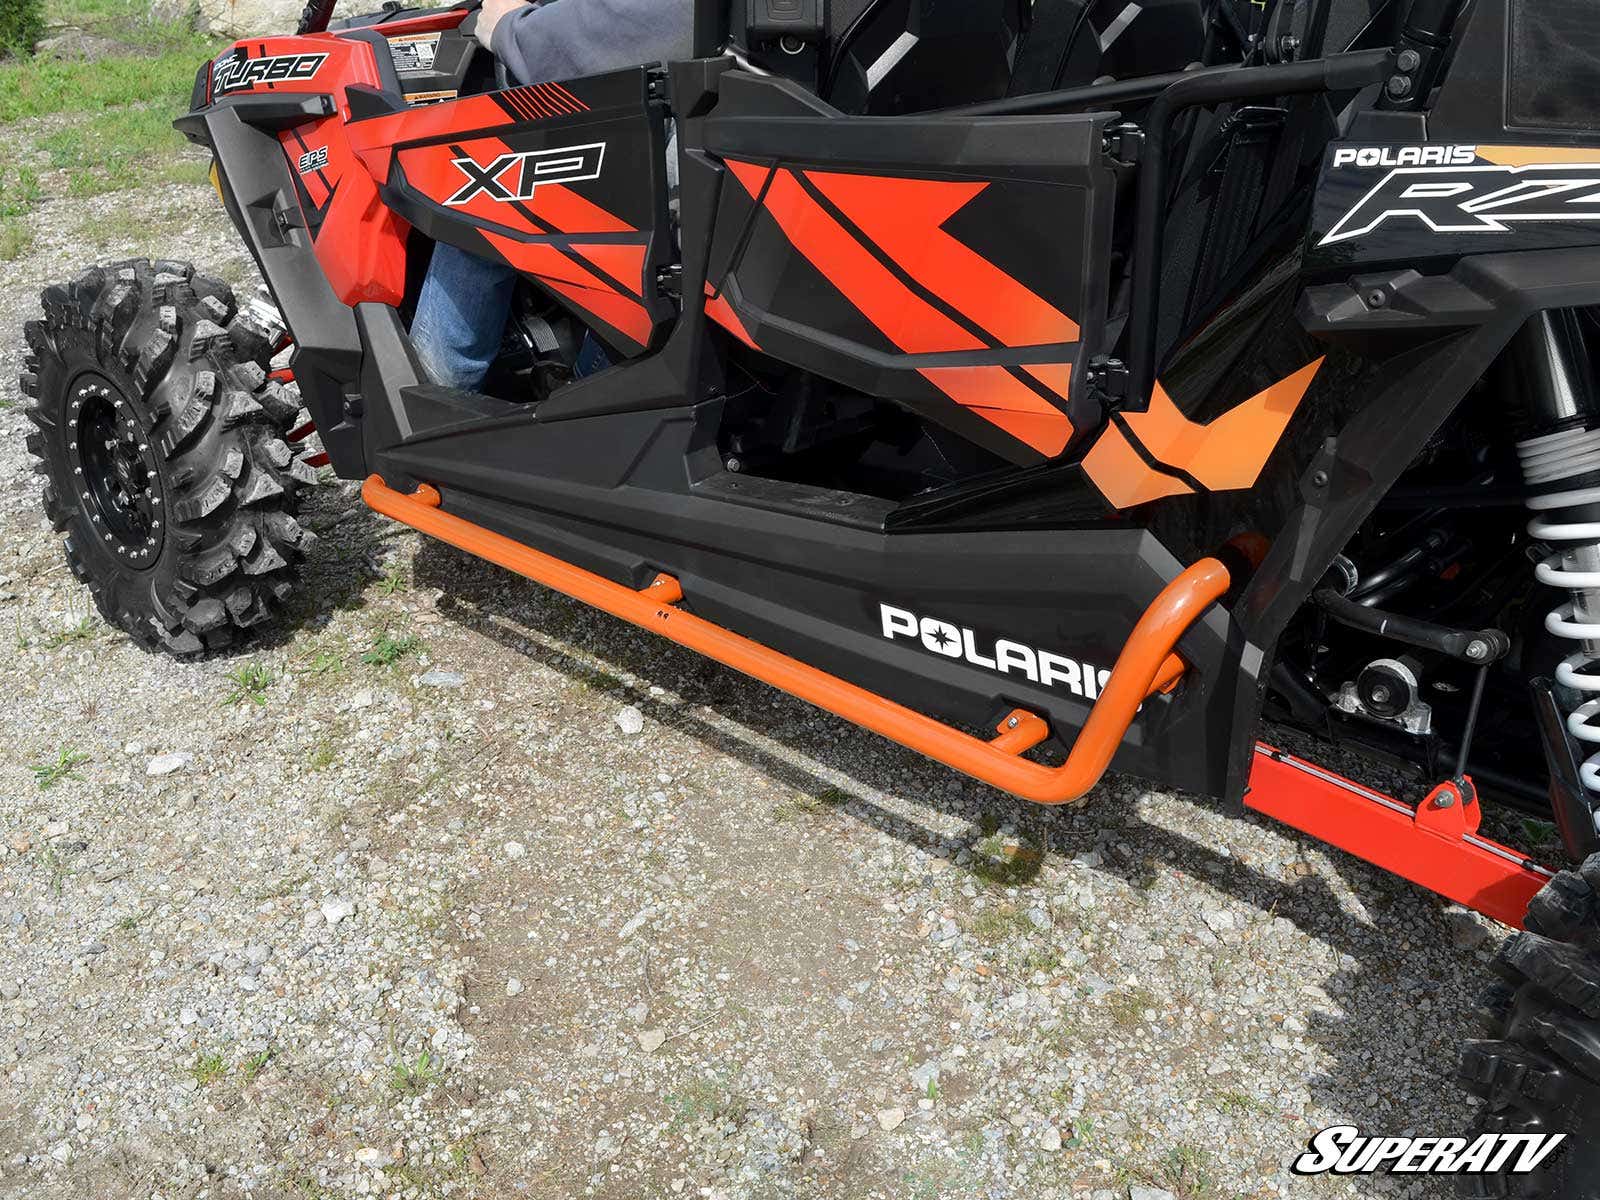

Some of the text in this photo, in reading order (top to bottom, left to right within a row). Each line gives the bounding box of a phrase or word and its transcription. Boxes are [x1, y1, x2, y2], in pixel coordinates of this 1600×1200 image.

[213, 52, 330, 94] TURBO
[298, 145, 329, 169] EPS
[1333, 145, 1477, 167] POLARIS
[442, 142, 606, 206] XP
